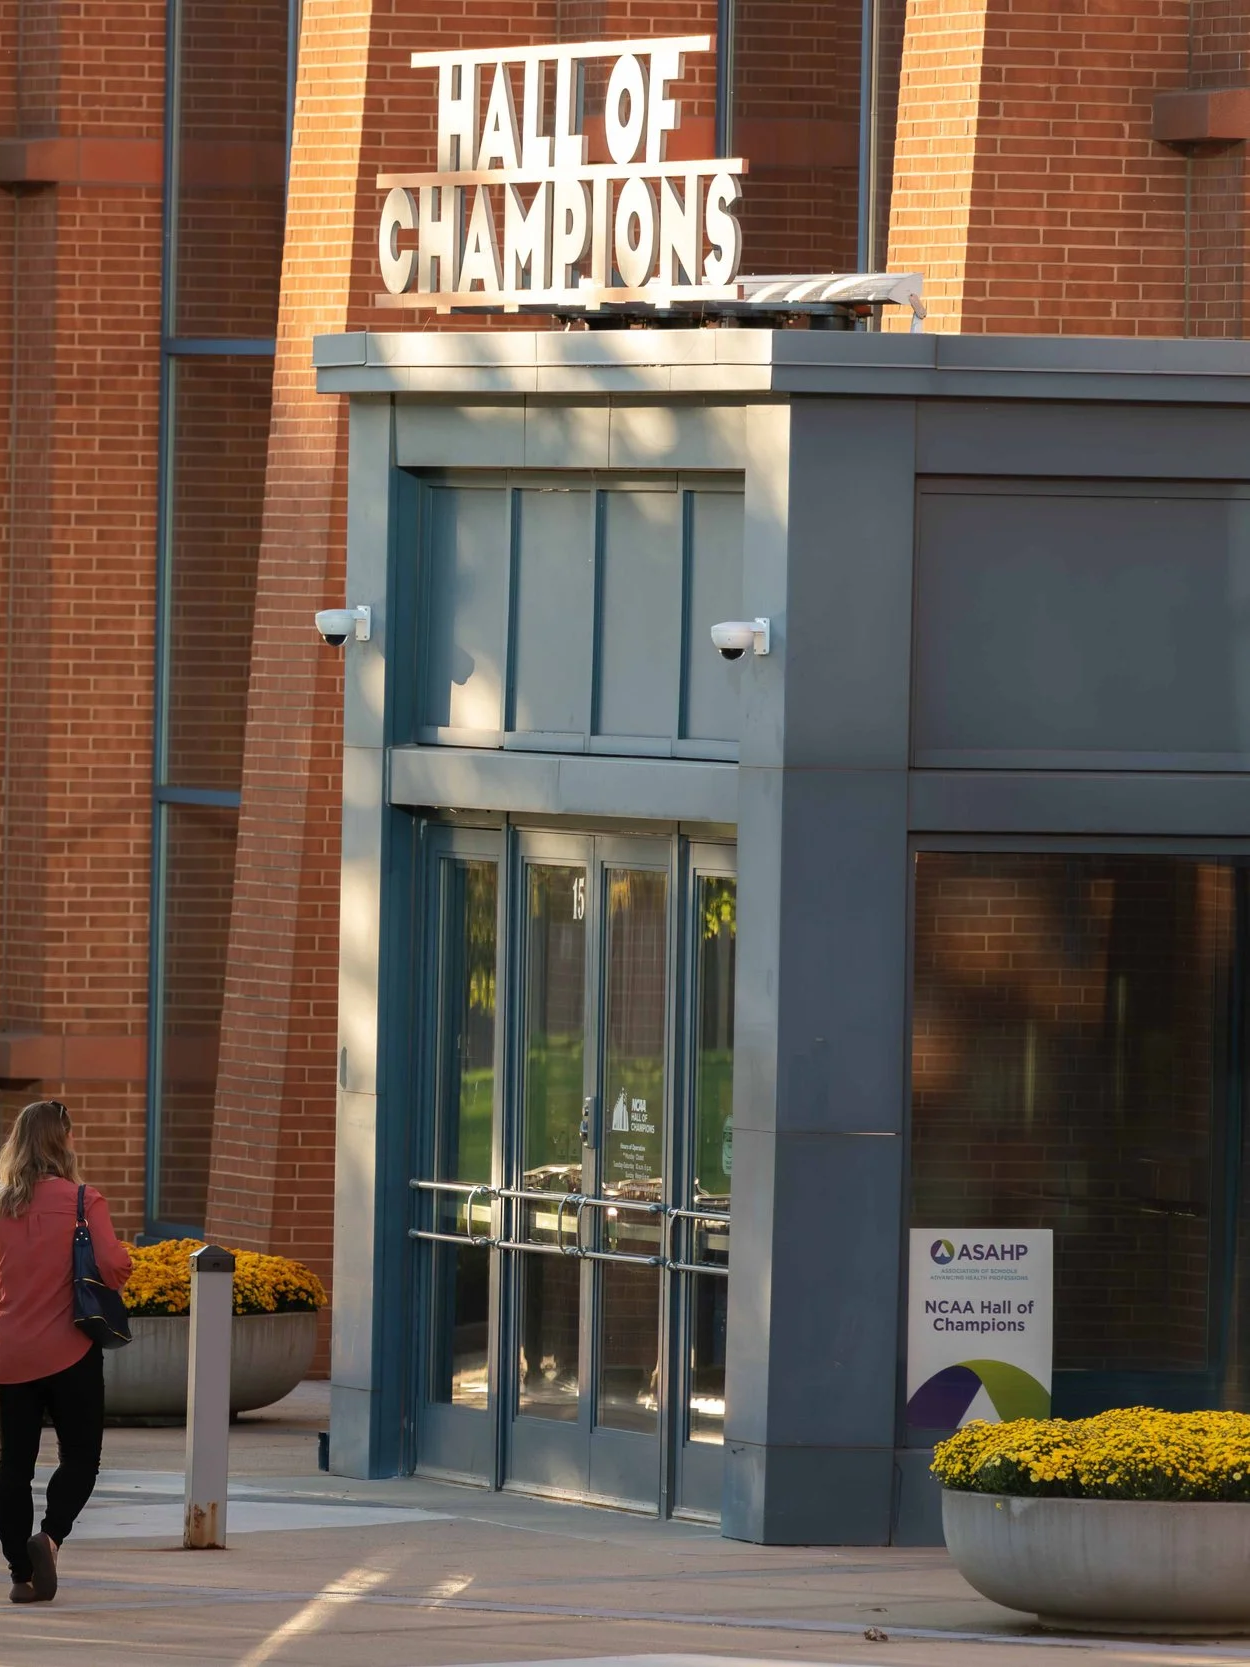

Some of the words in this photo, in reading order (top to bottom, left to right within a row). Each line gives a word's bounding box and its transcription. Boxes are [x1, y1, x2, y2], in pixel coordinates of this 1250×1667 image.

[437, 49, 588, 171] HALL
[604, 48, 686, 165] OF
[378, 173, 743, 294] CHAMPIONS
[572, 877, 585, 919] 15
[631, 1098, 646, 1112] NCAA
[631, 1112, 641, 1122] HALL
[642, 1114, 648, 1122] OF
[630, 1122, 654, 1134] CHAMPIONS
[957, 1244, 1028, 1261] ASAHP
[925, 1300, 975, 1314] NCAA
[981, 1300, 1011, 1314] Hall
[1017, 1300, 1034, 1314] of
[933, 1317, 1025, 1334] Champions
